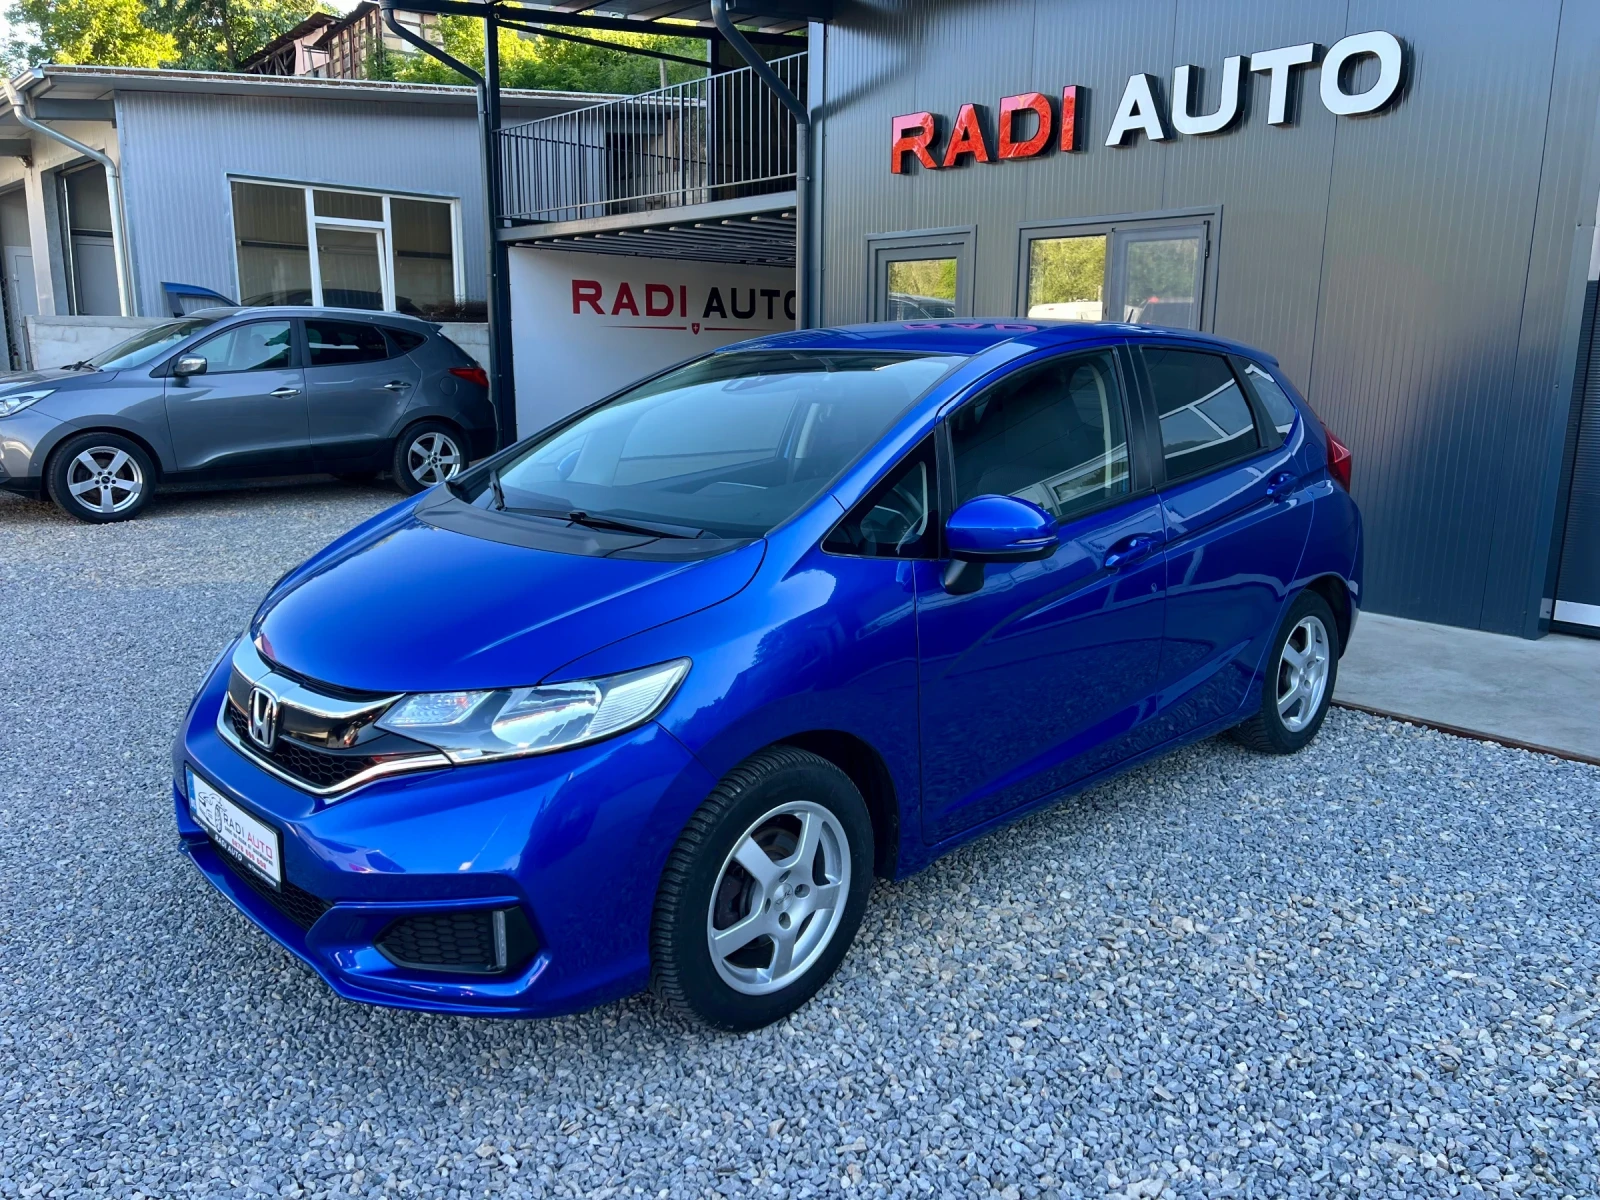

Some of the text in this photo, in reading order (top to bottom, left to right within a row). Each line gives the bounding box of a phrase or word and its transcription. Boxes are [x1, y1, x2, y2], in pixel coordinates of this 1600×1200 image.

[891, 29, 1405, 174] RADI AUTO
[571, 279, 687, 317] RADI
[214, 833, 228, 849] RADI
[227, 845, 242, 861] AUTO
[223, 812, 245, 839] RADI
[248, 831, 273, 860] AUTO
